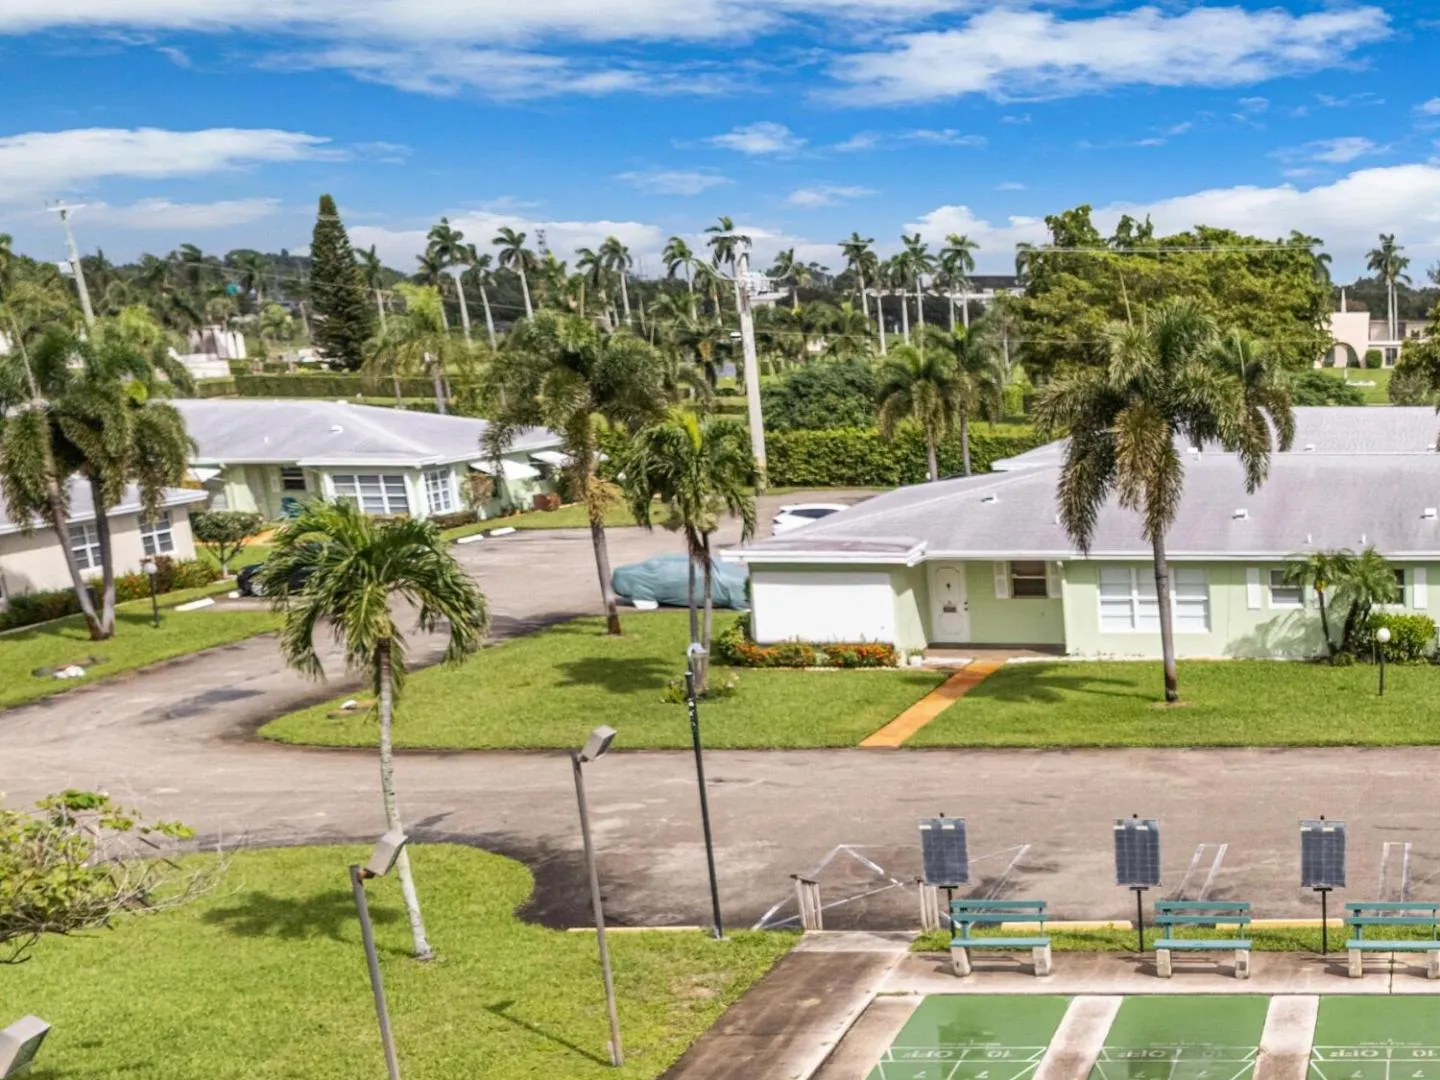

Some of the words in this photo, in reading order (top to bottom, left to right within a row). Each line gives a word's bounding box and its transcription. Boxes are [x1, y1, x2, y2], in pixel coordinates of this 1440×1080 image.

[1412, 1049, 1437, 1058] 10
[912, 1071, 927, 1079] 7
[976, 1071, 989, 1079] 7
[1351, 1070, 1364, 1078] 7
[1412, 1070, 1424, 1078] 7
